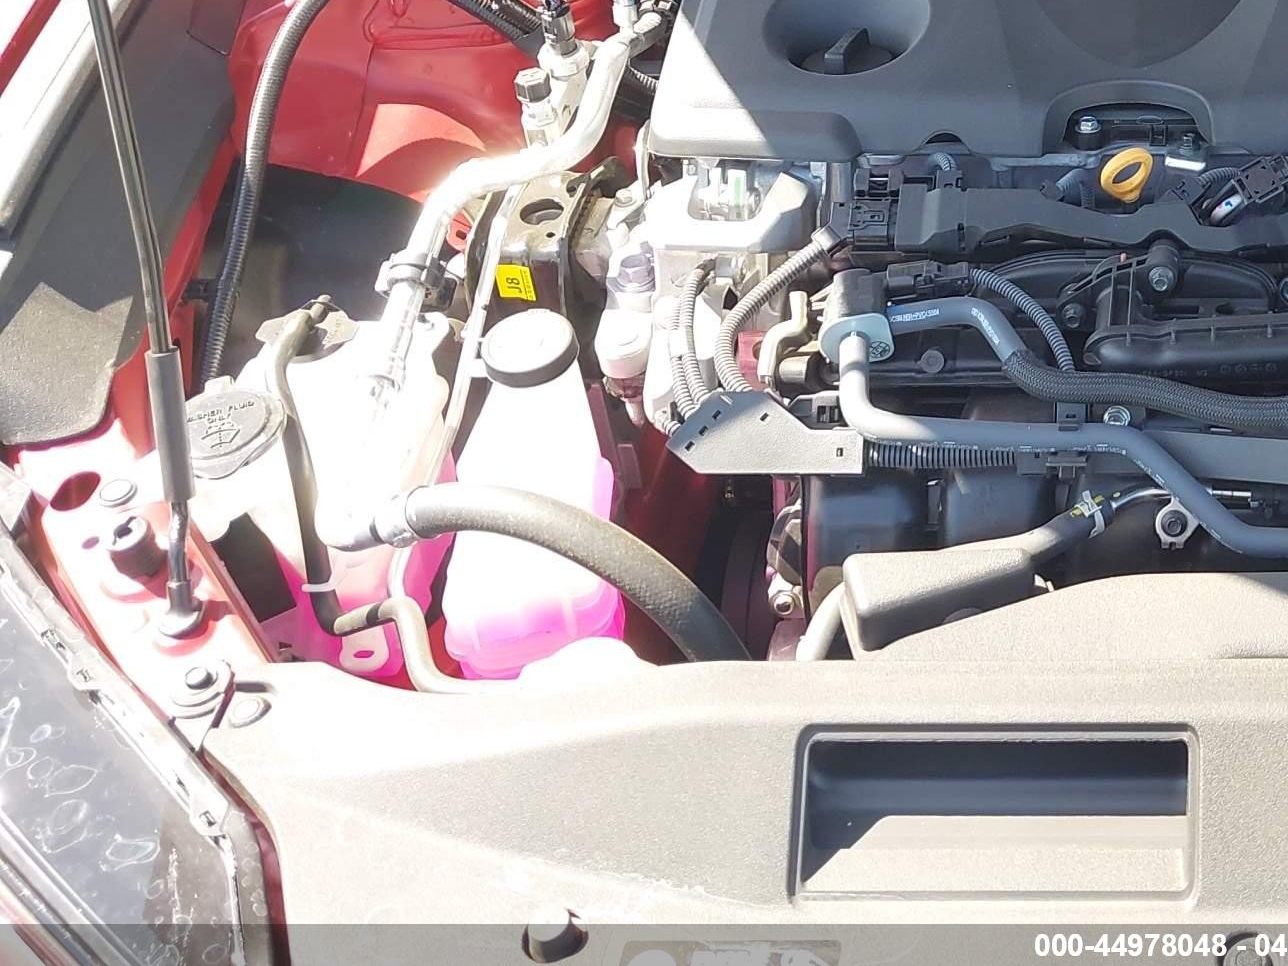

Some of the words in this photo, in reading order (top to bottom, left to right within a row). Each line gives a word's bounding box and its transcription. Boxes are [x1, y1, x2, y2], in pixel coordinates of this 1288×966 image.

[506, 277, 522, 293] J8
[186, 409, 223, 423] ASHER
[228, 401, 255, 412] FLUID
